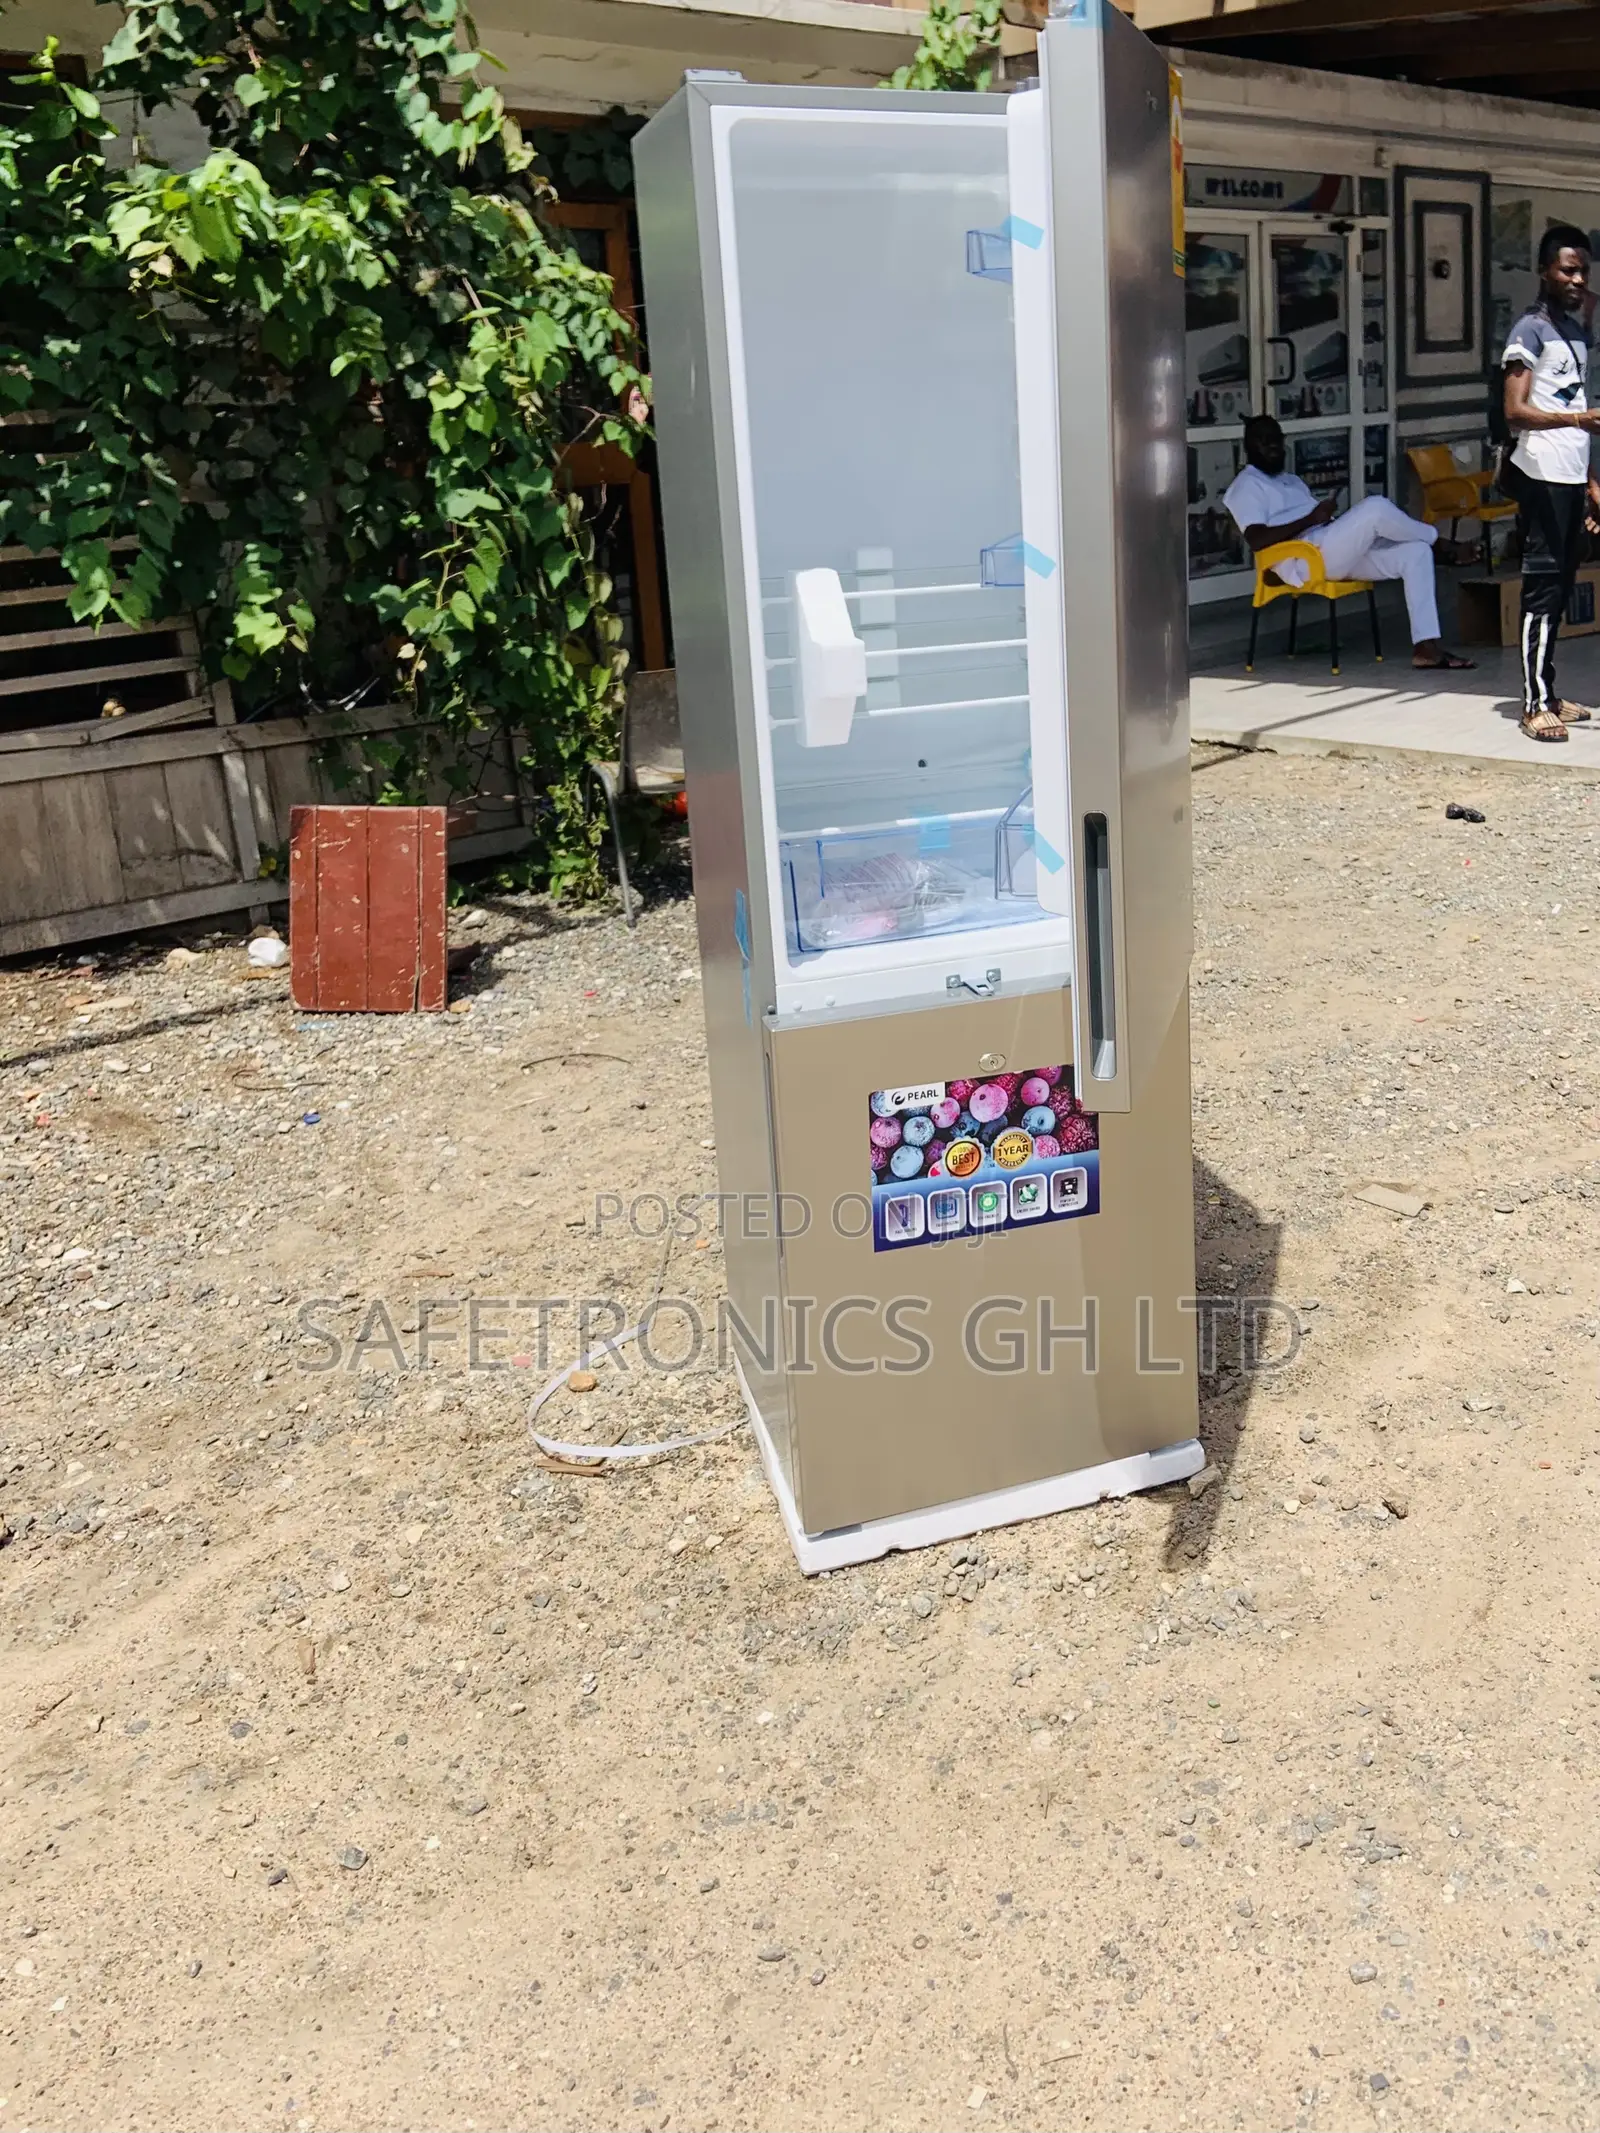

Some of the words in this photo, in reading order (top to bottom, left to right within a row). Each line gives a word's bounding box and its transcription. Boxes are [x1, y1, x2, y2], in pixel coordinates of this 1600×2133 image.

[907, 1089, 939, 1101] PEARL
[997, 1148, 1002, 1157] 1
[1003, 1144, 1029, 1156] YEAR
[952, 1151, 975, 1166] BEST
